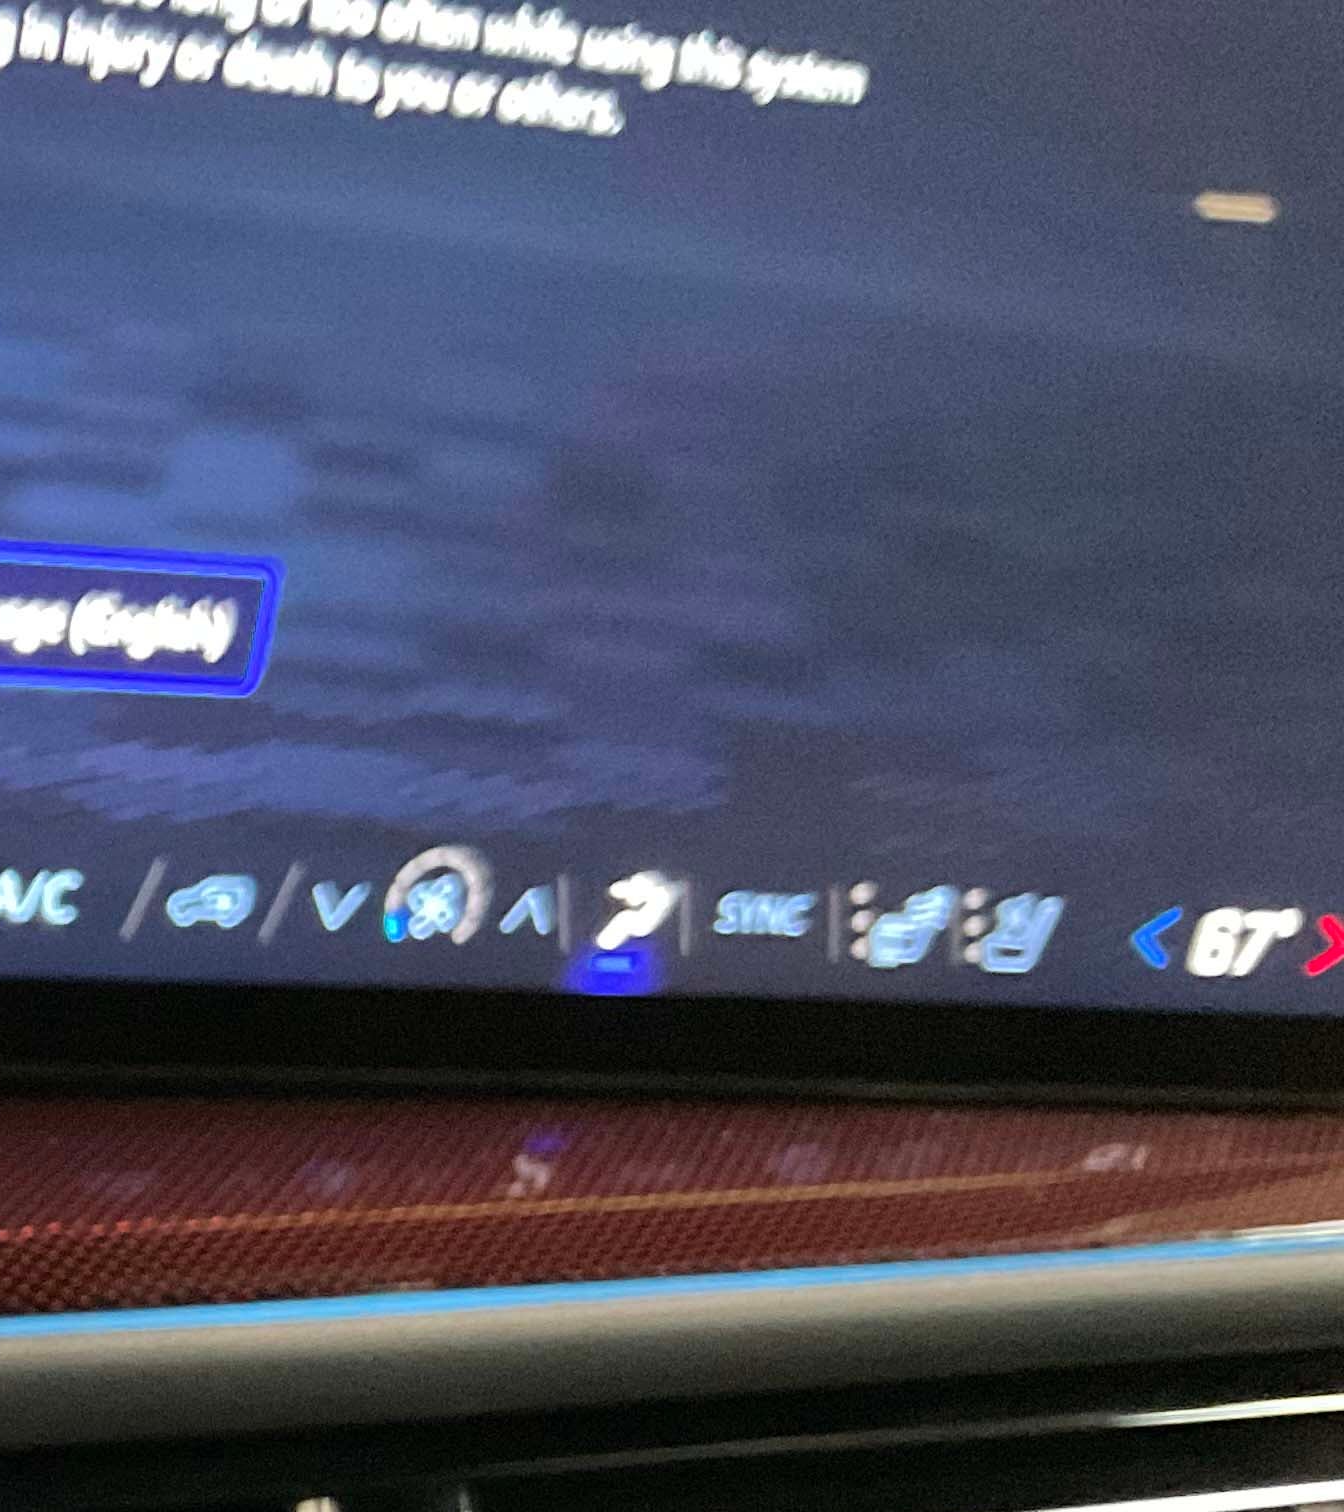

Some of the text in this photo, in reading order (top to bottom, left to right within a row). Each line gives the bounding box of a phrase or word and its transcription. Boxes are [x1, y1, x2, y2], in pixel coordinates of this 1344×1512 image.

[18, 3, 62, 62] in
[62, 8, 178, 88] injury
[173, 30, 224, 83] or
[221, 28, 335, 97] death
[334, 47, 382, 104] to
[373, 61, 455, 119] you
[448, 69, 503, 119] or
[481, 3, 580, 66] while
[576, 22, 678, 92] using
[674, 28, 747, 90] this
[743, 48, 869, 106] system
[713, 889, 817, 938] SYNC
